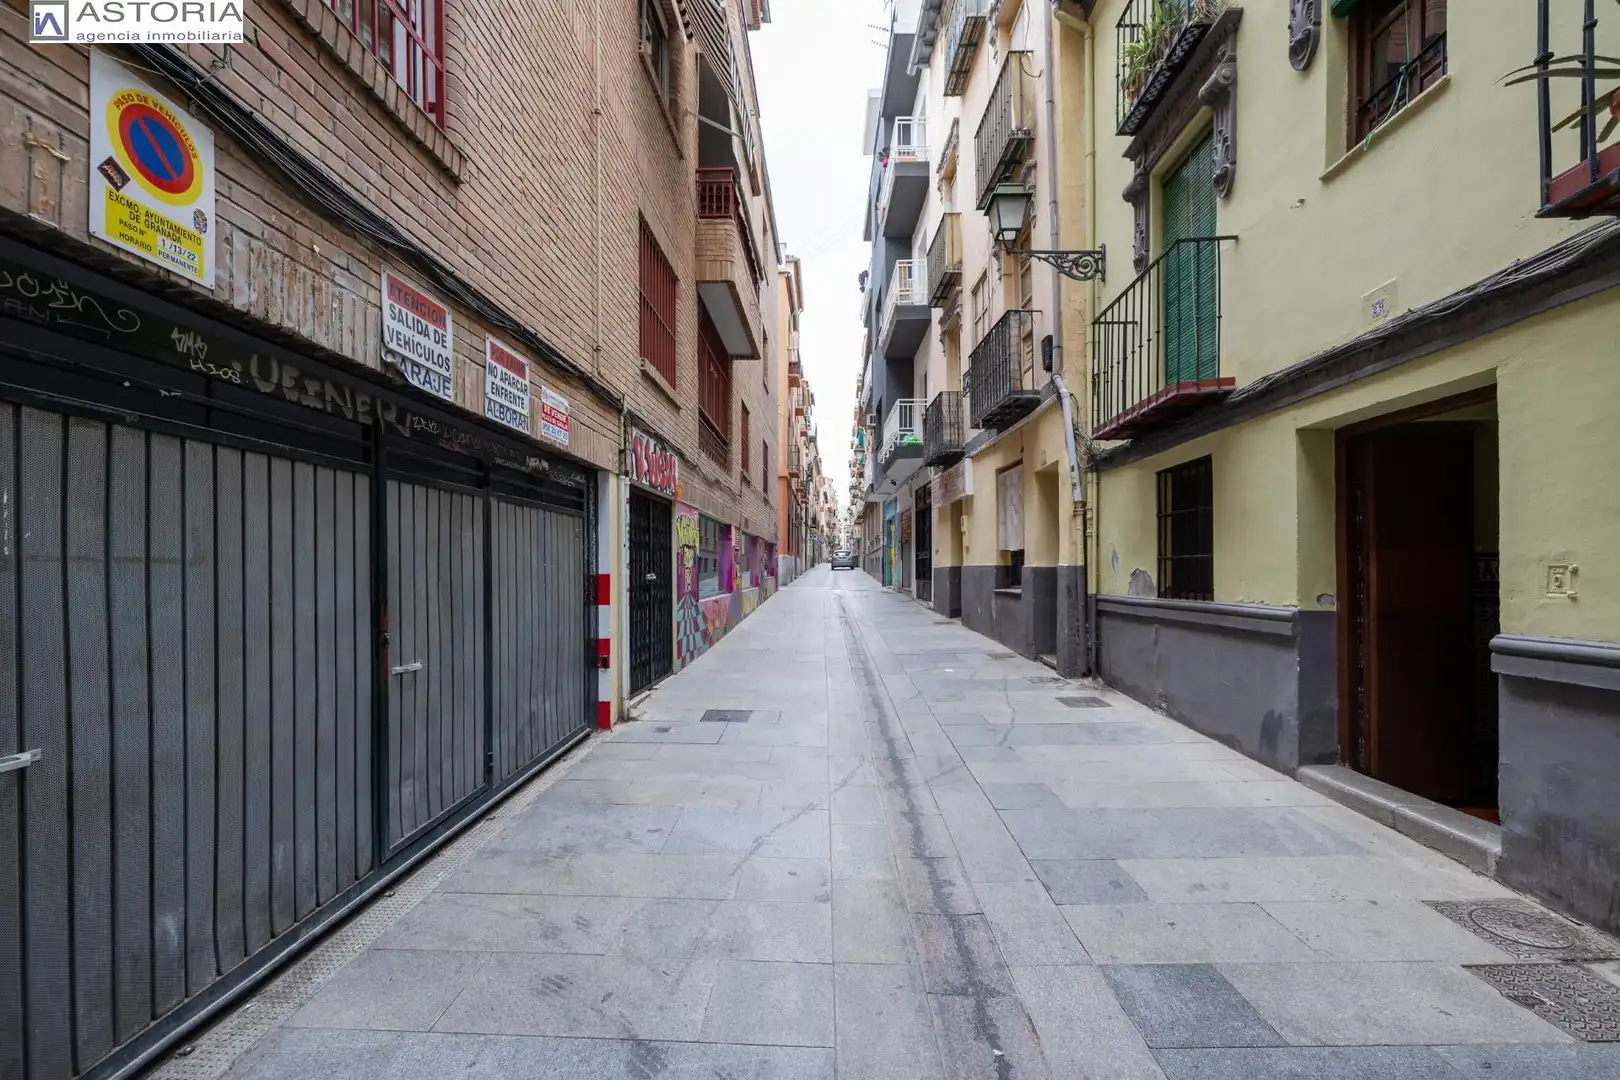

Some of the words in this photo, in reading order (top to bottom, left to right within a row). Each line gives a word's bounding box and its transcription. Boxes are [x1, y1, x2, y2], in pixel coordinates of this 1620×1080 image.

[113, 93, 134, 111] PASO
[136, 94, 149, 104] DE
[109, 190, 142, 215] EXCMO.
[144, 210, 202, 246] AYUNTAMIENTO
[119, 218, 138, 233] PASO
[129, 211, 141, 224] DE
[144, 220, 182, 245] GRANADA
[119, 232, 152, 252] HORARIO
[158, 249, 198, 274] PERMANENTE
[389, 302, 431, 341] SALIDA
[434, 329, 448, 350] DE
[387, 325, 451, 373] VEHÍCULOS
[488, 362, 498, 379] NO
[499, 370, 529, 396] APARCAR
[491, 381, 525, 410] ENFRENTE
[486, 400, 530, 433] ALBORAN
